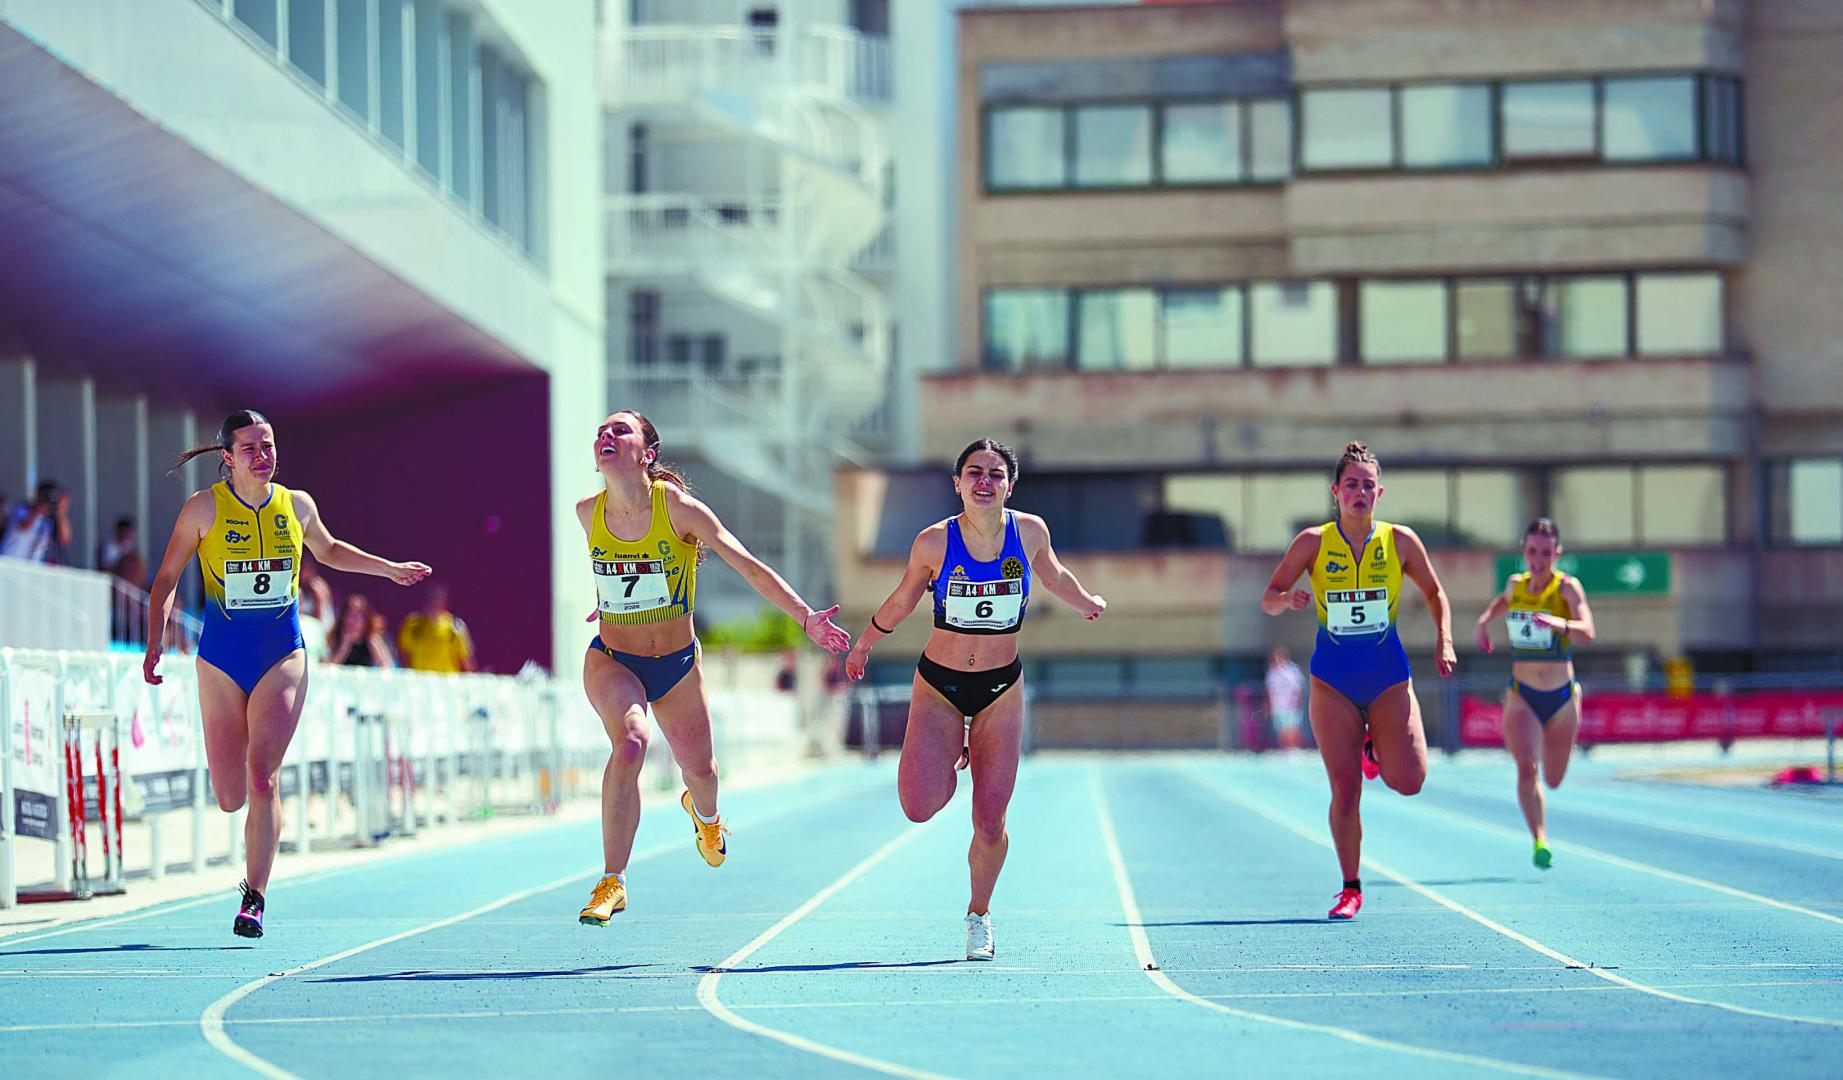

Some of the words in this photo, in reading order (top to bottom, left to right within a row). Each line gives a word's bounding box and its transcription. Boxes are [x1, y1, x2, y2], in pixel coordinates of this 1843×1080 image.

[253, 574, 271, 594] 8
[621, 575, 640, 598] 7
[975, 601, 993, 618] 6
[1351, 606, 1366, 624] 5
[1521, 624, 1531, 637] 4
